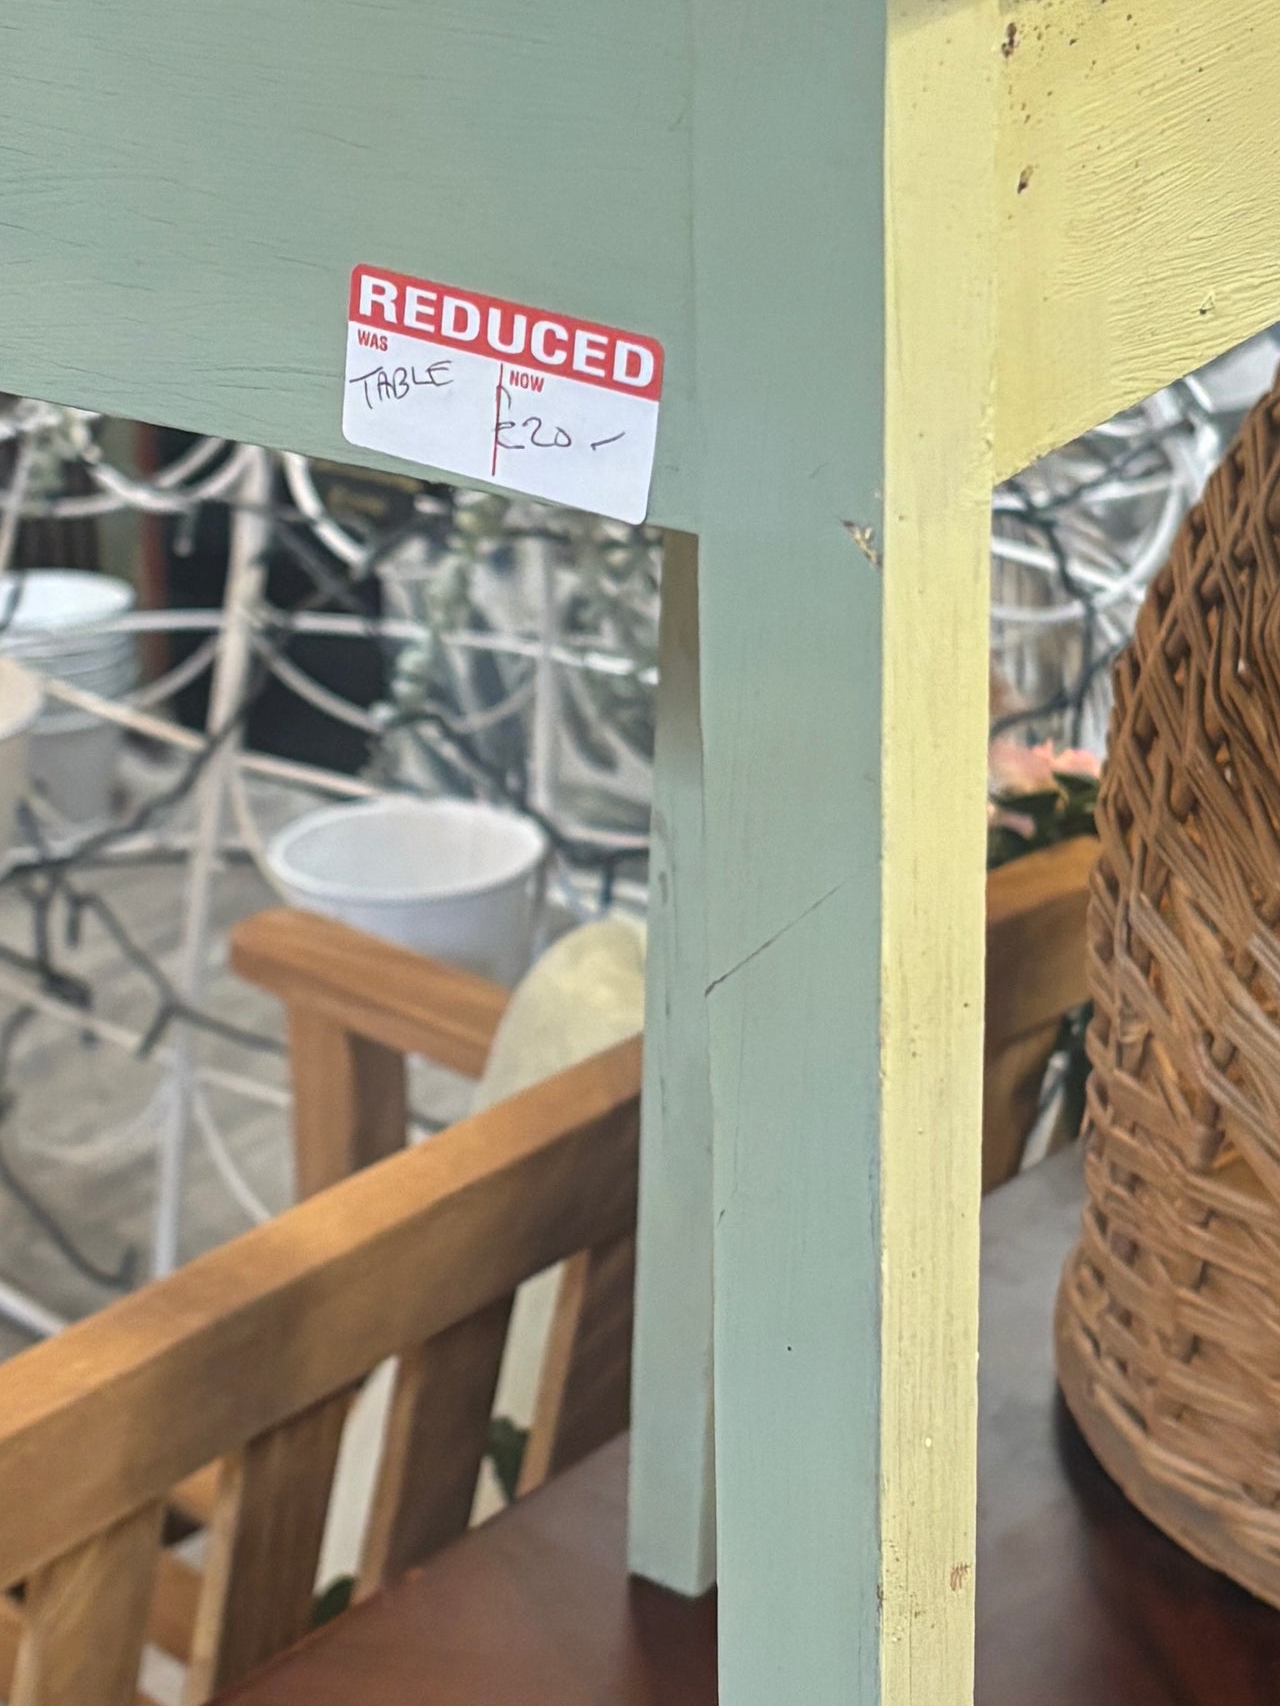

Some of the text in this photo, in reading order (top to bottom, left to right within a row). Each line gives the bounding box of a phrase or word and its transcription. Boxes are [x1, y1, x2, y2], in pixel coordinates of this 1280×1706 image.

[357, 329, 388, 352] WAS
[359, 274, 655, 388] REDUCED
[349, 360, 455, 410] TABLE
[508, 370, 545, 393] NOW
